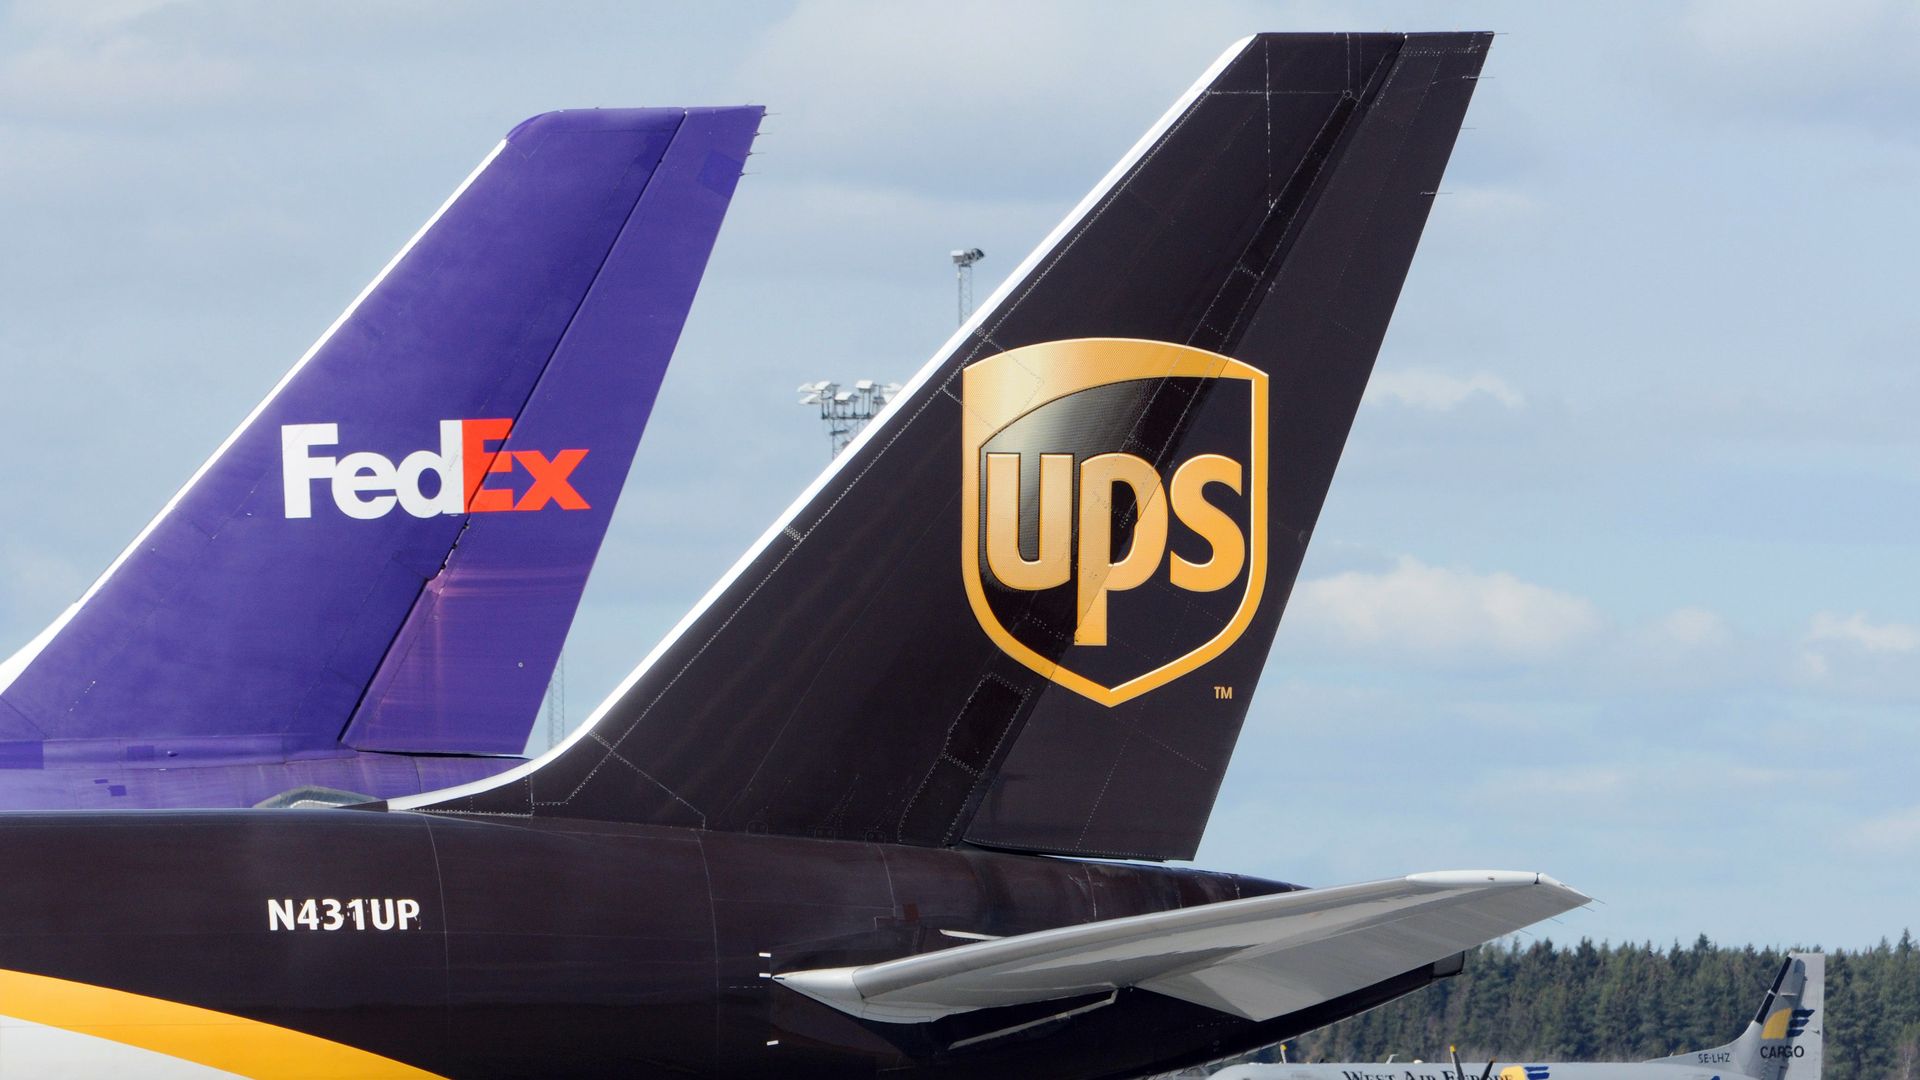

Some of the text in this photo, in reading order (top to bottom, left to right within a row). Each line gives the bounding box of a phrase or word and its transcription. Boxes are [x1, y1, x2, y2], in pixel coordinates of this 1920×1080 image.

[280, 418, 592, 519] FedEx
[986, 453, 1246, 646] ups
[1213, 686, 1233, 700] TM
[267, 898, 421, 931] N431UP
[1698, 1052, 1731, 1064] SE-LHZ
[1760, 1045, 1805, 1059] CARGO
